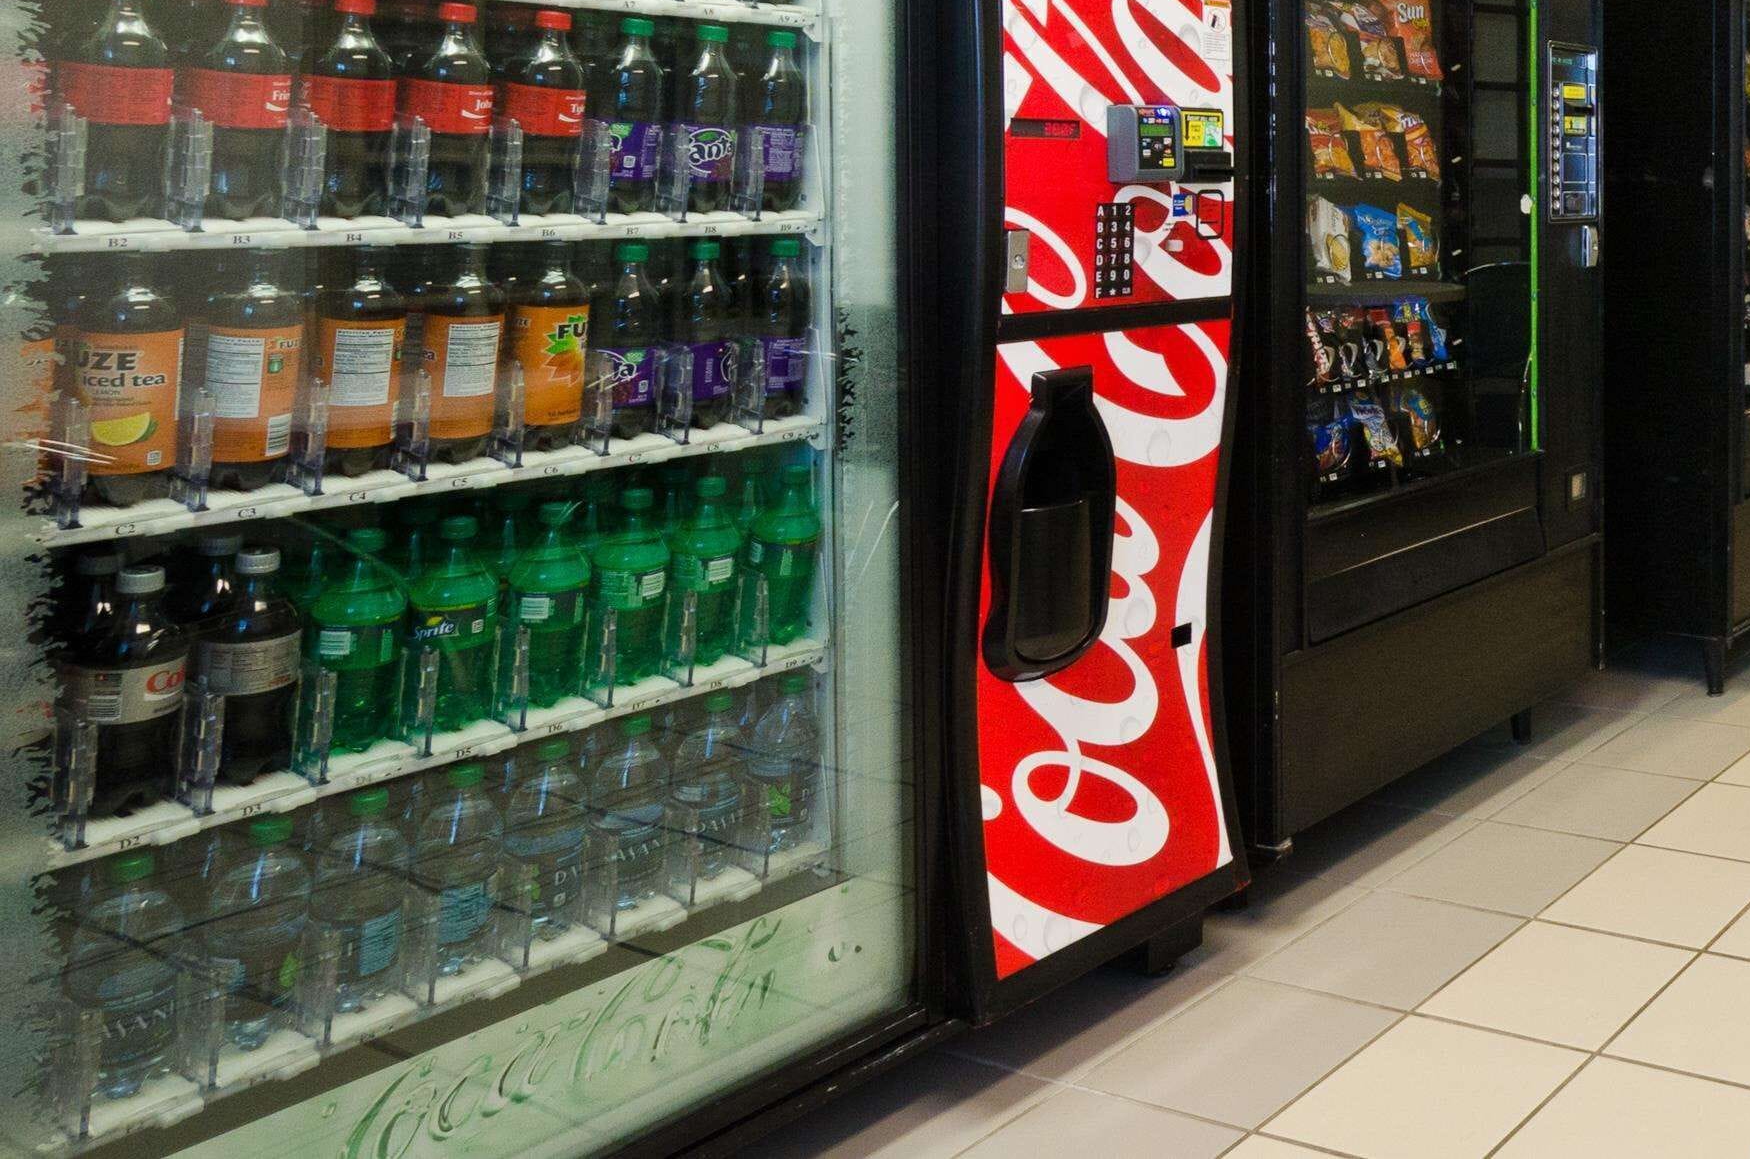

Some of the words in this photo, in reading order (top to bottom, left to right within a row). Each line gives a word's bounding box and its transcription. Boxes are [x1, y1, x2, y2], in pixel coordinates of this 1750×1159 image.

[1097, 205, 1105, 217] A
[1111, 205, 1117, 215] 1
[1125, 204, 1132, 215] 2
[704, 225, 717, 234] B8
[780, 223, 792, 232] B9
[1097, 222, 1104, 233] B
[1111, 221, 1118, 232] 3
[1124, 221, 1131, 231] 4
[448, 231, 463, 241] B5
[541, 228, 556, 238] B6
[626, 228, 639, 236] B7
[108, 238, 128, 248] B2
[233, 235, 251, 245] B3
[346, 233, 362, 243] B4
[1110, 238, 1117, 249] 5
[1124, 237, 1131, 248] 6
[1096, 238, 1103, 250] C
[1096, 255, 1103, 266] D
[1110, 254, 1117, 265] 7
[1123, 253, 1130, 264] 8
[1096, 271, 1102, 282] E
[1110, 269, 1117, 281] 9
[1123, 269, 1130, 280] 0
[1095, 287, 1102, 299] F
[83, 372, 126, 387] iced
[132, 374, 166, 387] tea
[706, 442, 720, 451] C8
[543, 465, 559, 475] C6
[452, 476, 468, 488] C5
[350, 492, 366, 503] C4
[115, 523, 136, 536] C2
[413, 619, 455, 639] Sprite
[456, 748, 472, 759] D5
